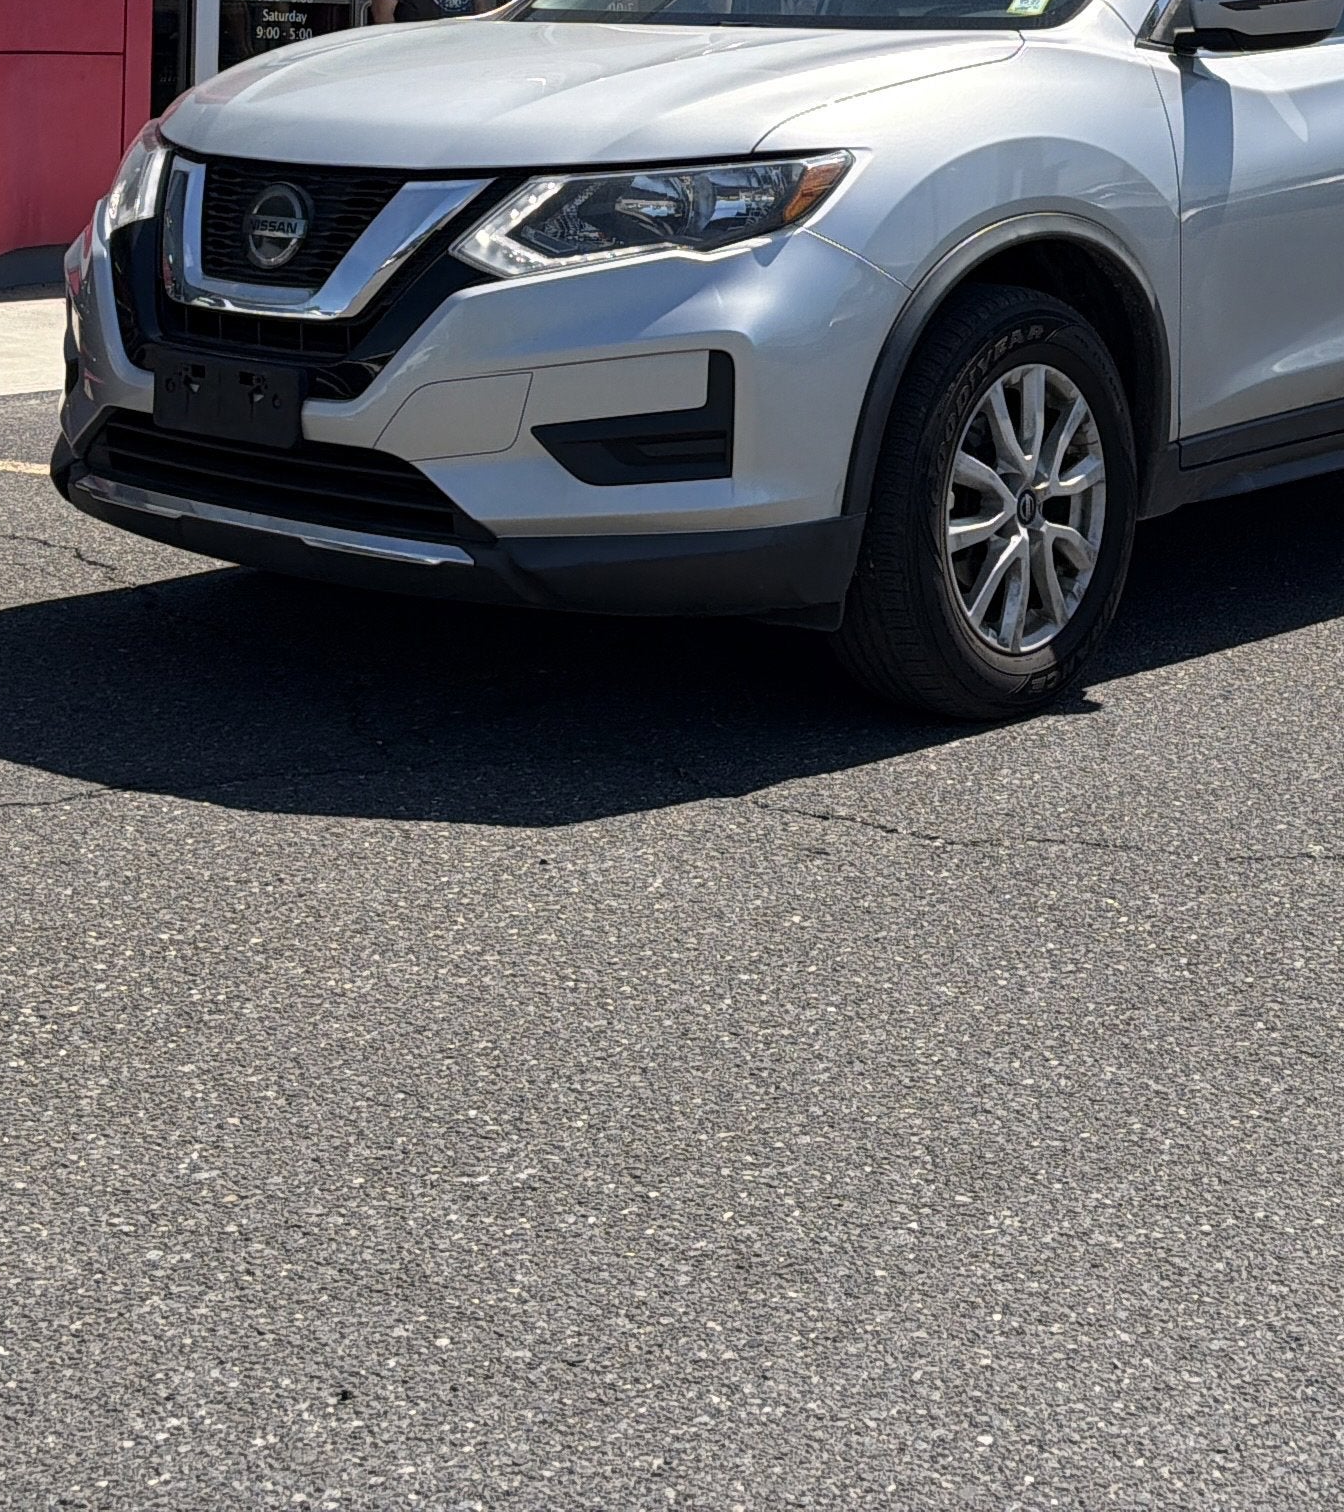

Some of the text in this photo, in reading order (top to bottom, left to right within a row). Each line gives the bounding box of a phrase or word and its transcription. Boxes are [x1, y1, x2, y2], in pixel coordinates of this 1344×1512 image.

[262, 9, 308, 25] Saturday
[256, 26, 280, 39] 9:00
[289, 28, 313, 40] 5:00
[250, 219, 298, 235] NISSAN
